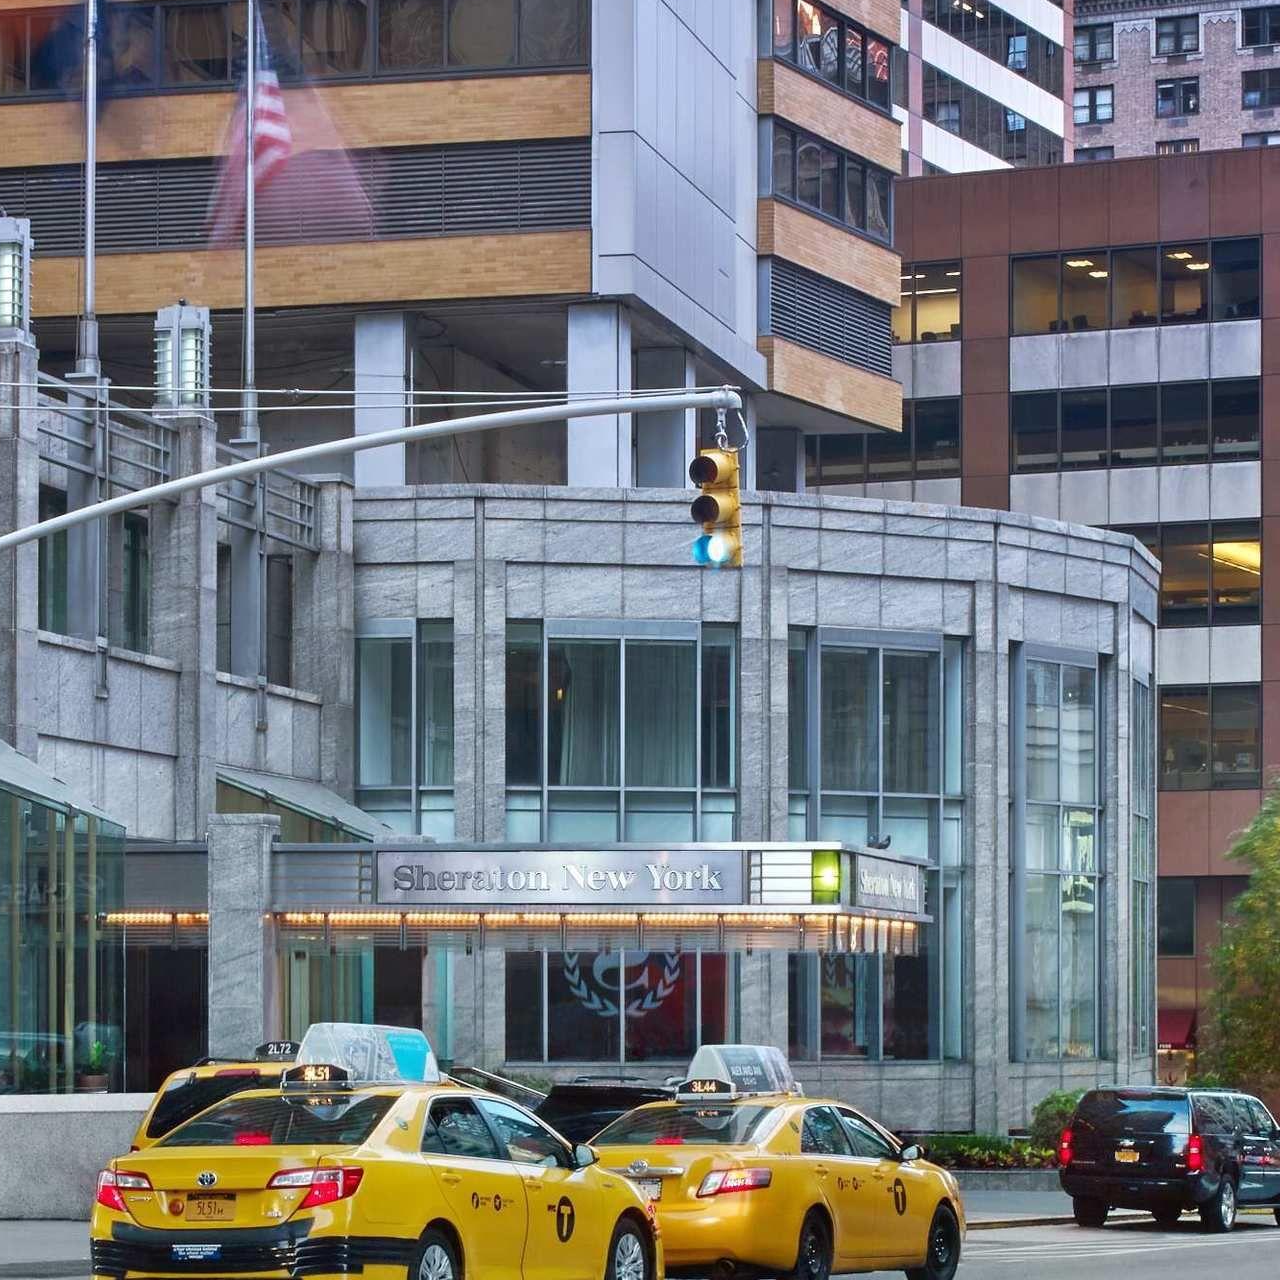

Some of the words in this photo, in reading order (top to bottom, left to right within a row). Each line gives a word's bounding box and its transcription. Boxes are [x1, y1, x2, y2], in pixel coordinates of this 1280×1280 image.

[393, 864, 549, 892] Sheraton
[562, 865, 635, 891] New
[646, 864, 723, 891] York
[268, 1043, 292, 1054] 2L72
[691, 1081, 716, 1093] 3L44
